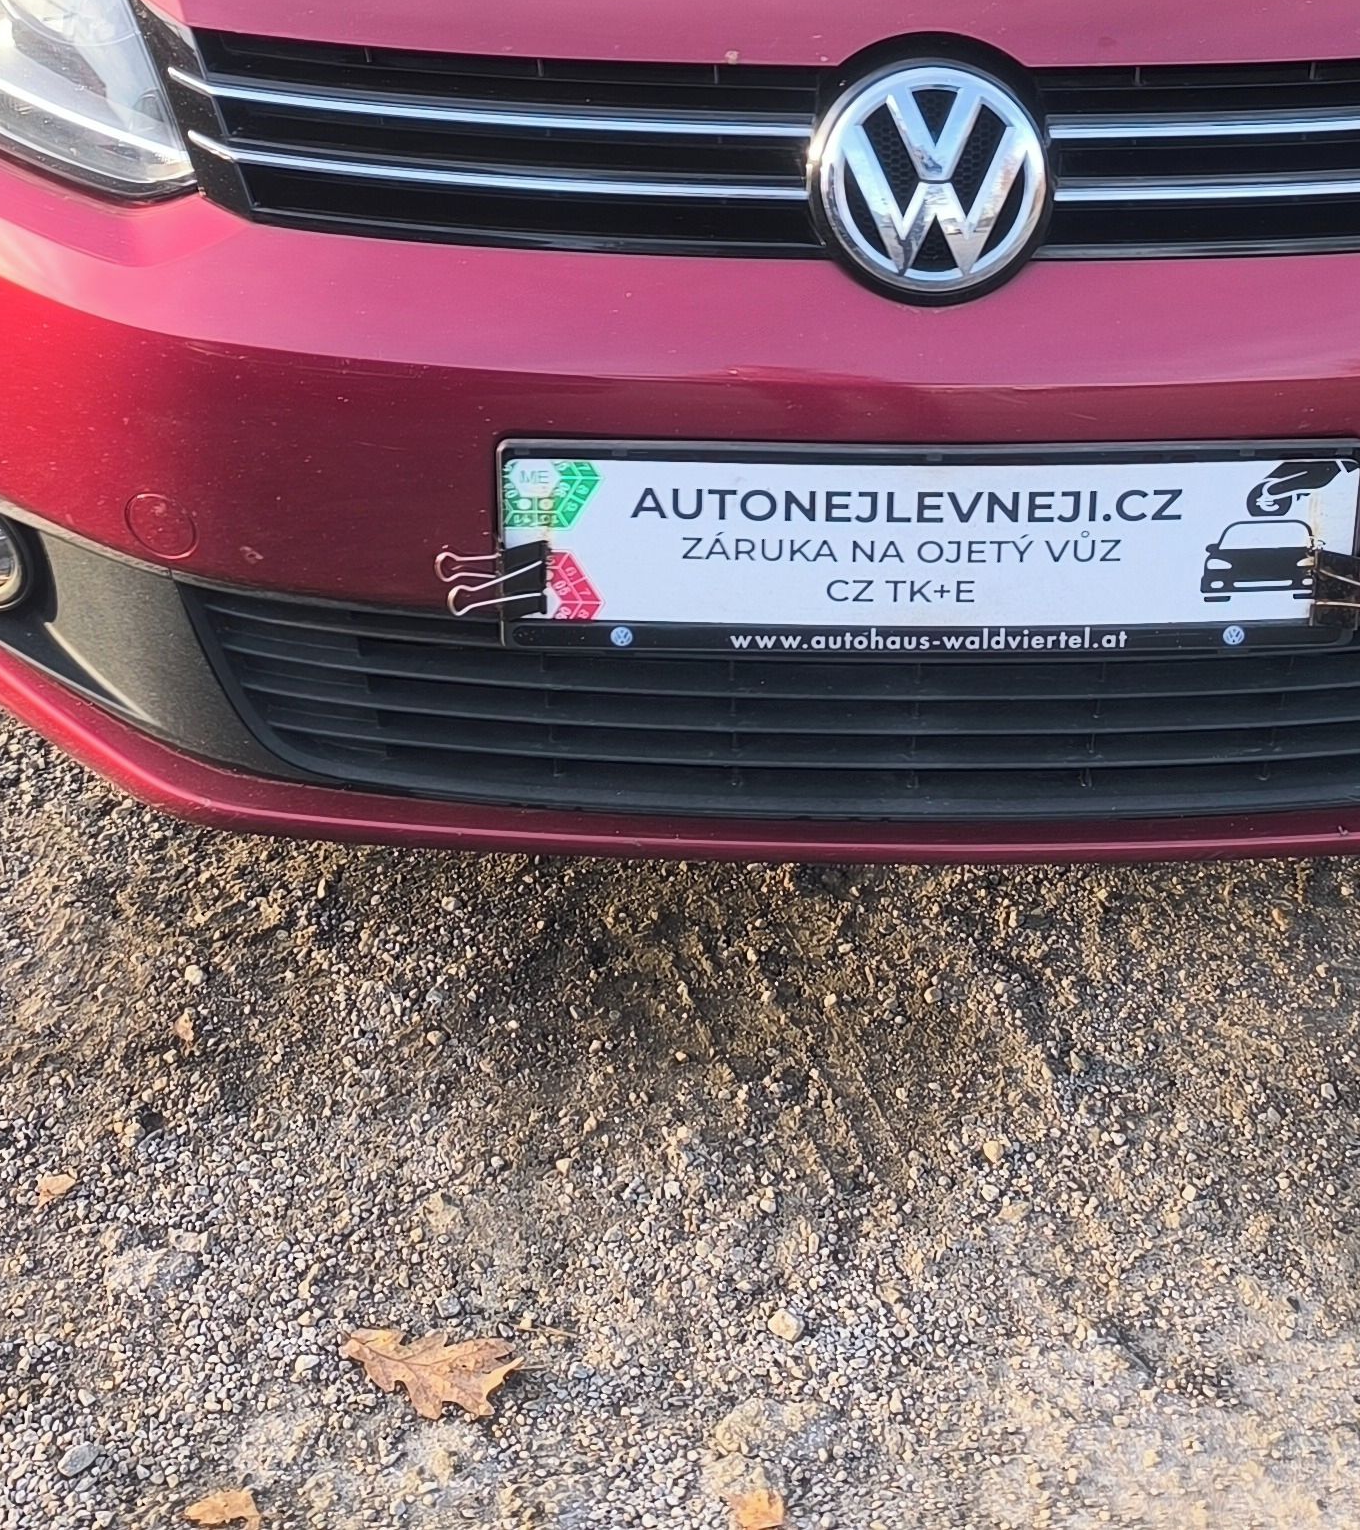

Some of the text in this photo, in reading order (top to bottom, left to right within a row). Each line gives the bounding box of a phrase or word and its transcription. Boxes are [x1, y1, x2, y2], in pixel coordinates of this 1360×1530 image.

[630, 486, 1184, 524] AUTONEJLEVNEJI.CZ
[681, 530, 1123, 564] ZÁRUKA NA OJETÝ VŮZ
[825, 579, 976, 603] CZ TK+E
[730, 627, 1128, 650] www.autohaus-waldviertel.at
